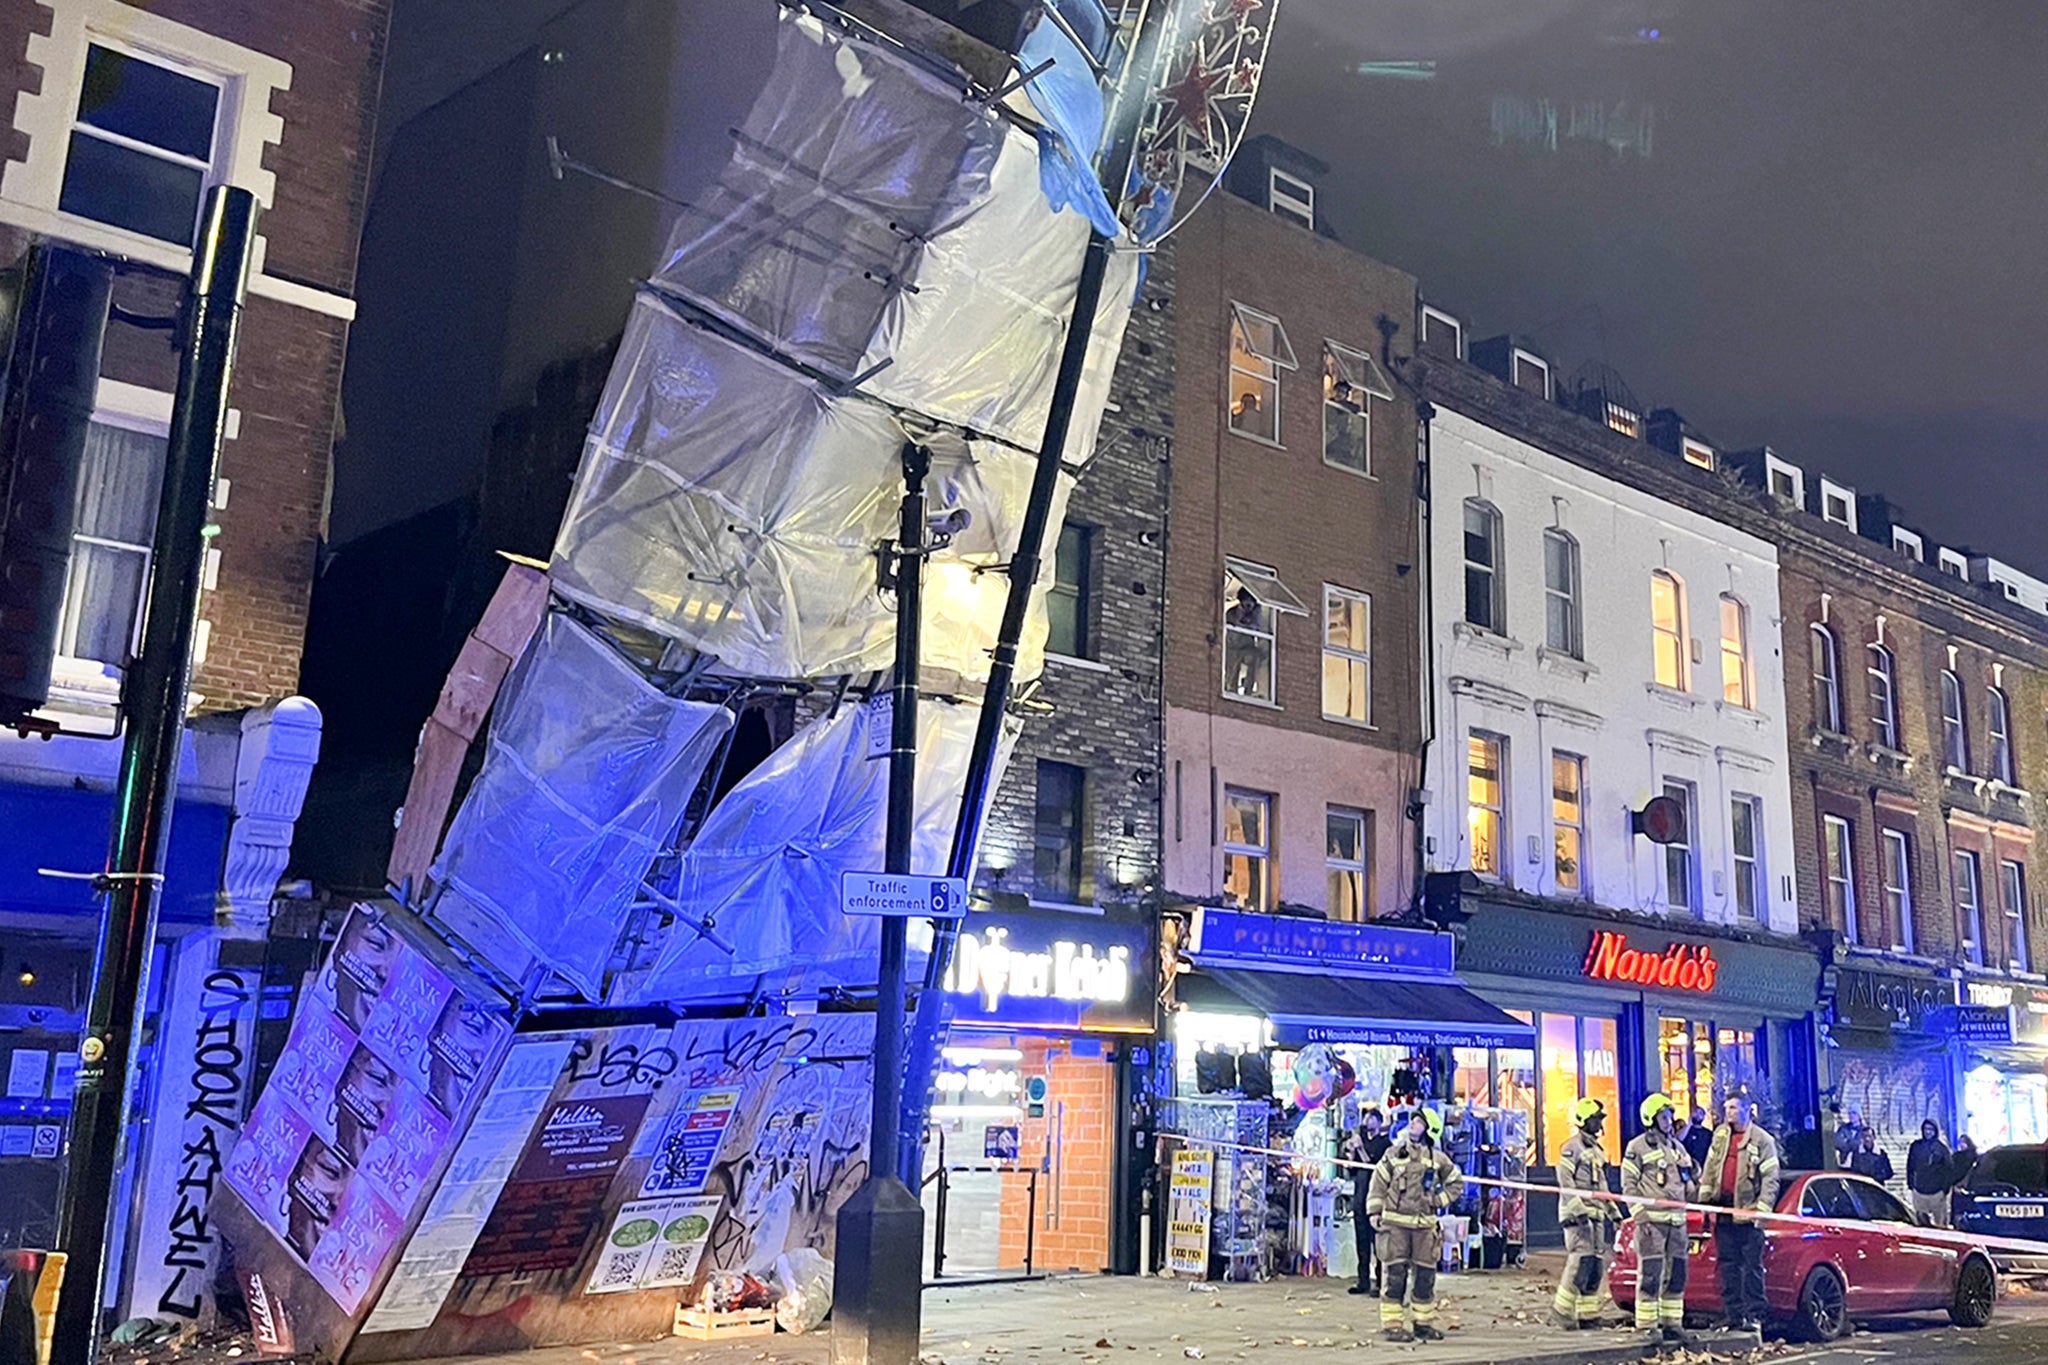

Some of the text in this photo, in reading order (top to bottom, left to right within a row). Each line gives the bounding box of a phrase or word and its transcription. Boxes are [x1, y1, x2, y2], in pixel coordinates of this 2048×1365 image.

[848, 895, 927, 910] enforcement
[868, 880, 908, 894] Traffic
[1590, 930, 1718, 992] Nando's
[388, 984, 431, 1027] FEST
[398, 963, 442, 1006] PINK
[305, 1014, 346, 1057] PINK
[1326, 1030, 1369, 1041] Household
[1960, 1023, 2008, 1033] JEWELLERS
[296, 1034, 335, 1076] FEST
[261, 1103, 299, 1147] PINK
[386, 1119, 427, 1163] FEST
[396, 1098, 439, 1144] PINK
[252, 1123, 289, 1167] FEST
[339, 1214, 378, 1259] FEST
[349, 1193, 389, 1238] PINK
